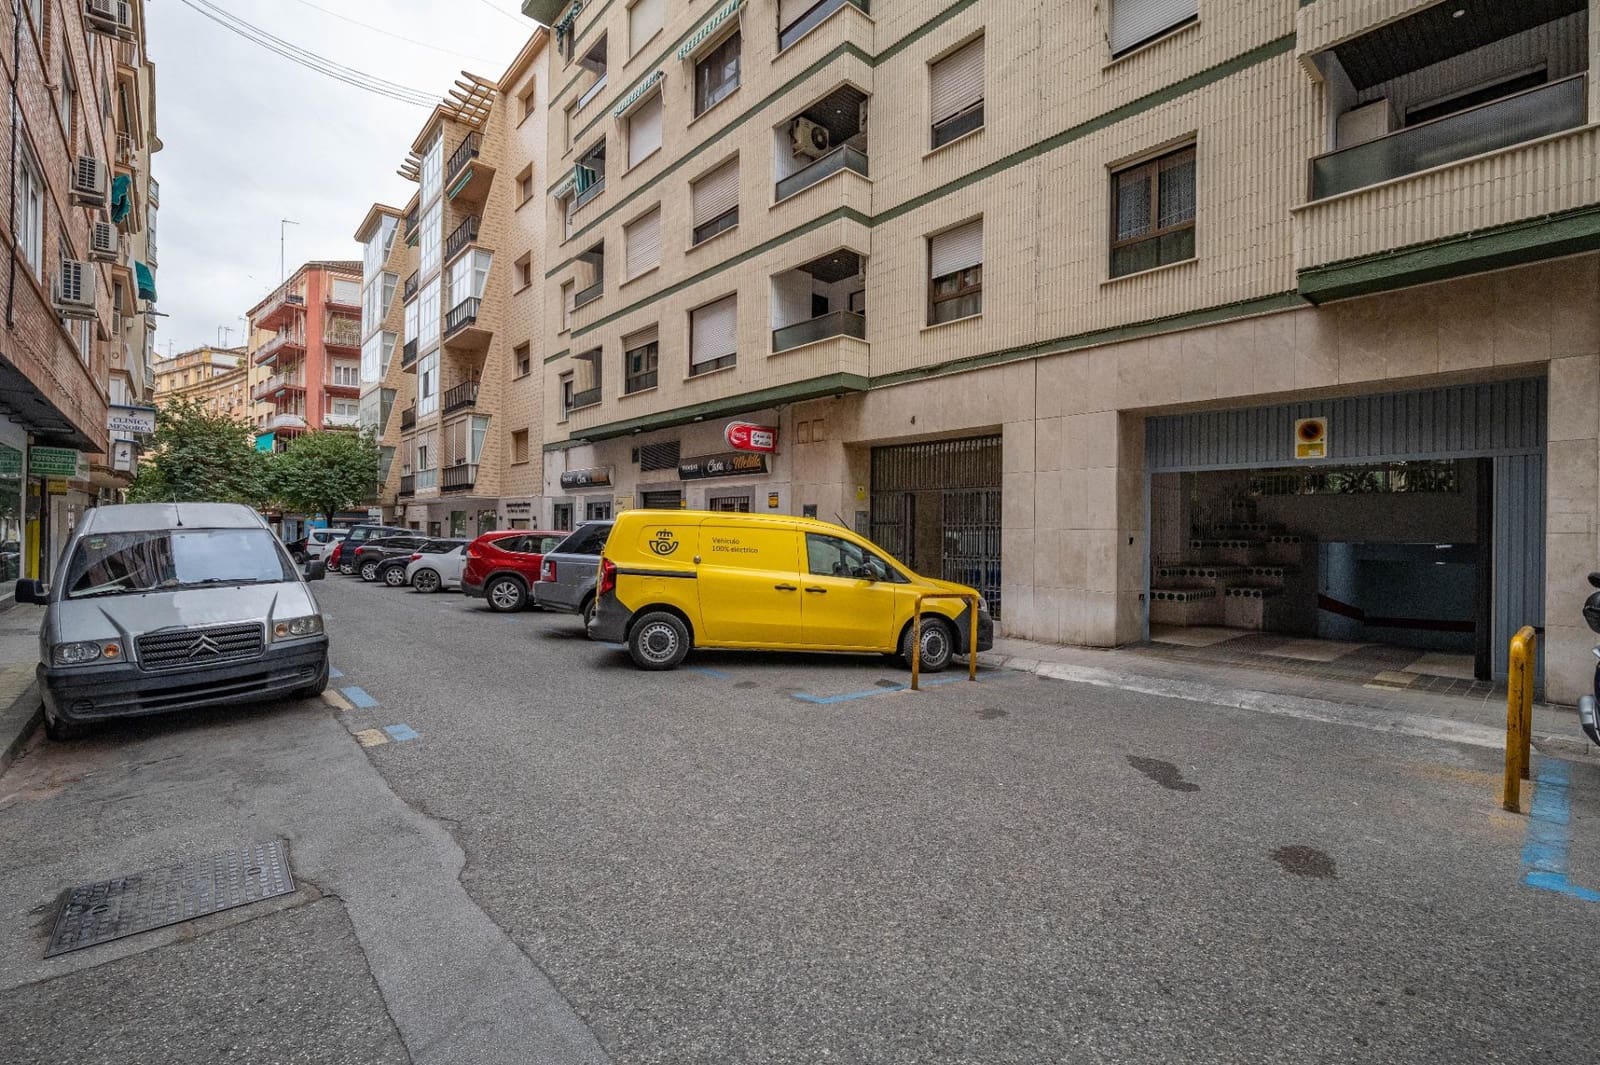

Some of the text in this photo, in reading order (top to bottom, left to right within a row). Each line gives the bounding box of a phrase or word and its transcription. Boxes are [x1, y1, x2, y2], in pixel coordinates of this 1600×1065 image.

[109, 423, 152, 433] MENORCA
[707, 459, 724, 472] Casa
[733, 454, 761, 469] Melilla
